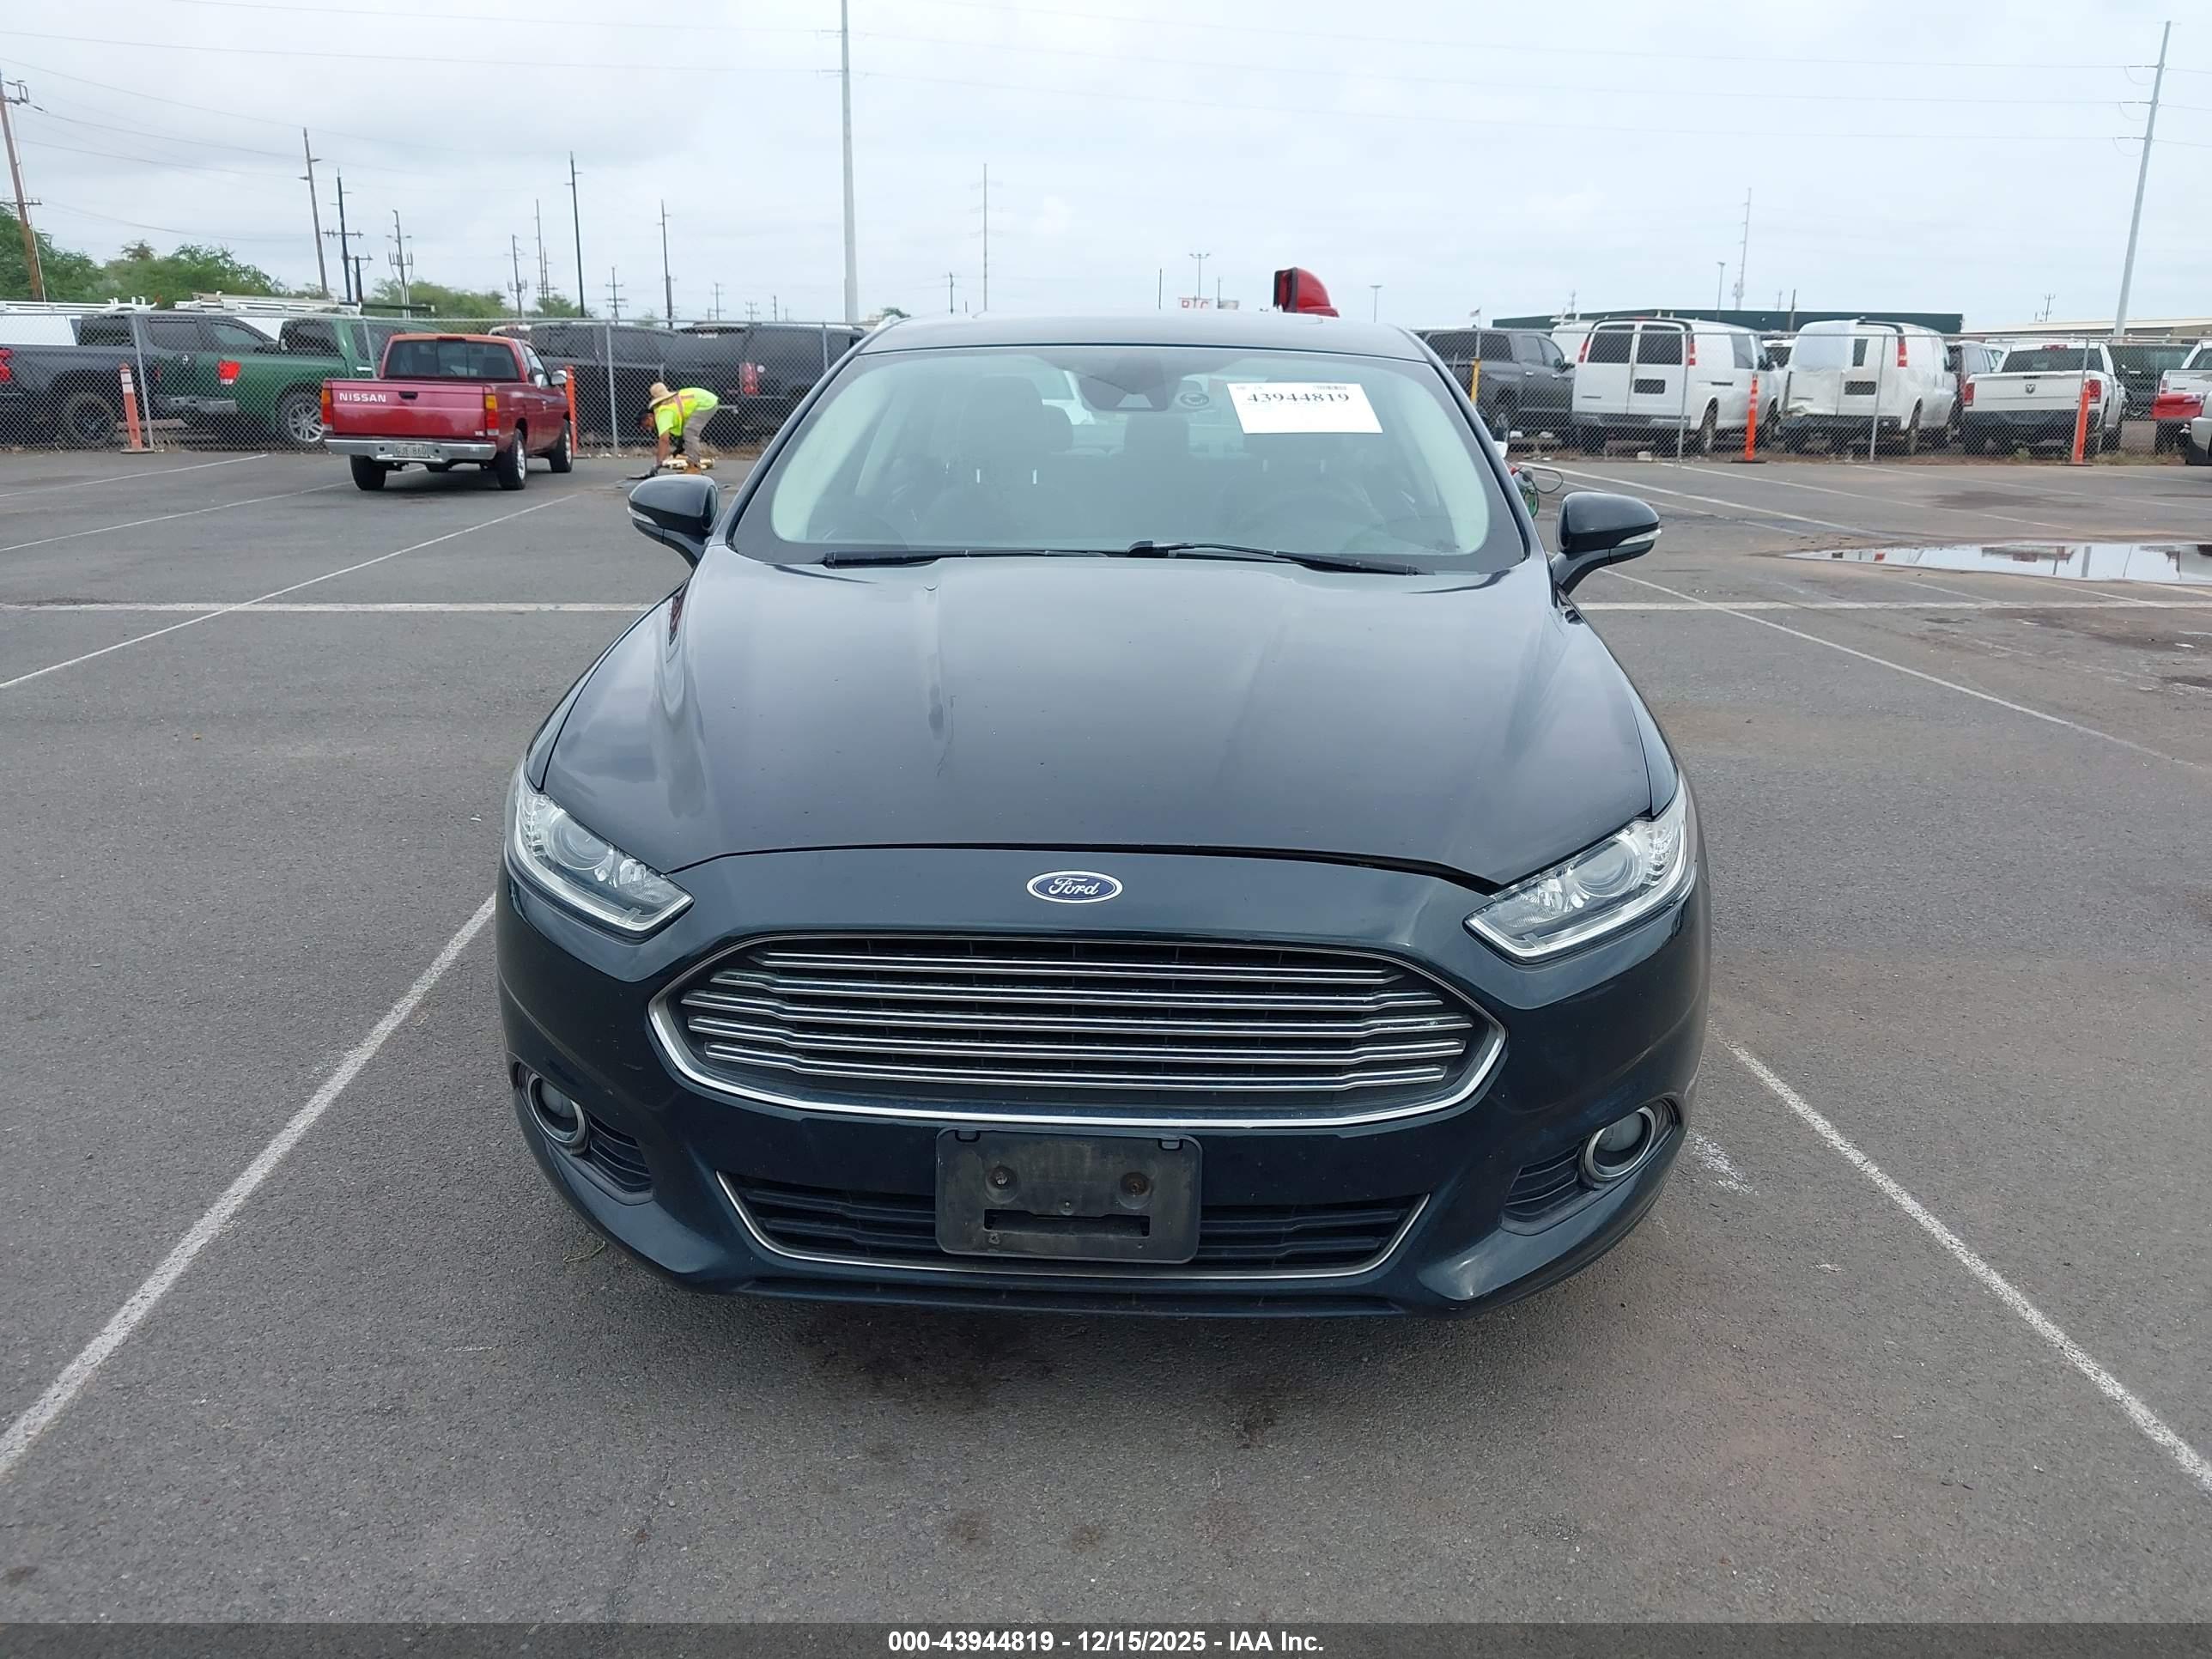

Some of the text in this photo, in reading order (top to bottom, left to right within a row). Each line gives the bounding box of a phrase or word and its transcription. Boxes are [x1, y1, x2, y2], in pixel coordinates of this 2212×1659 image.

[339, 392, 386, 403] NISSAN
[1247, 392, 1350, 403] 43944819
[1048, 877, 1101, 896] Ford
